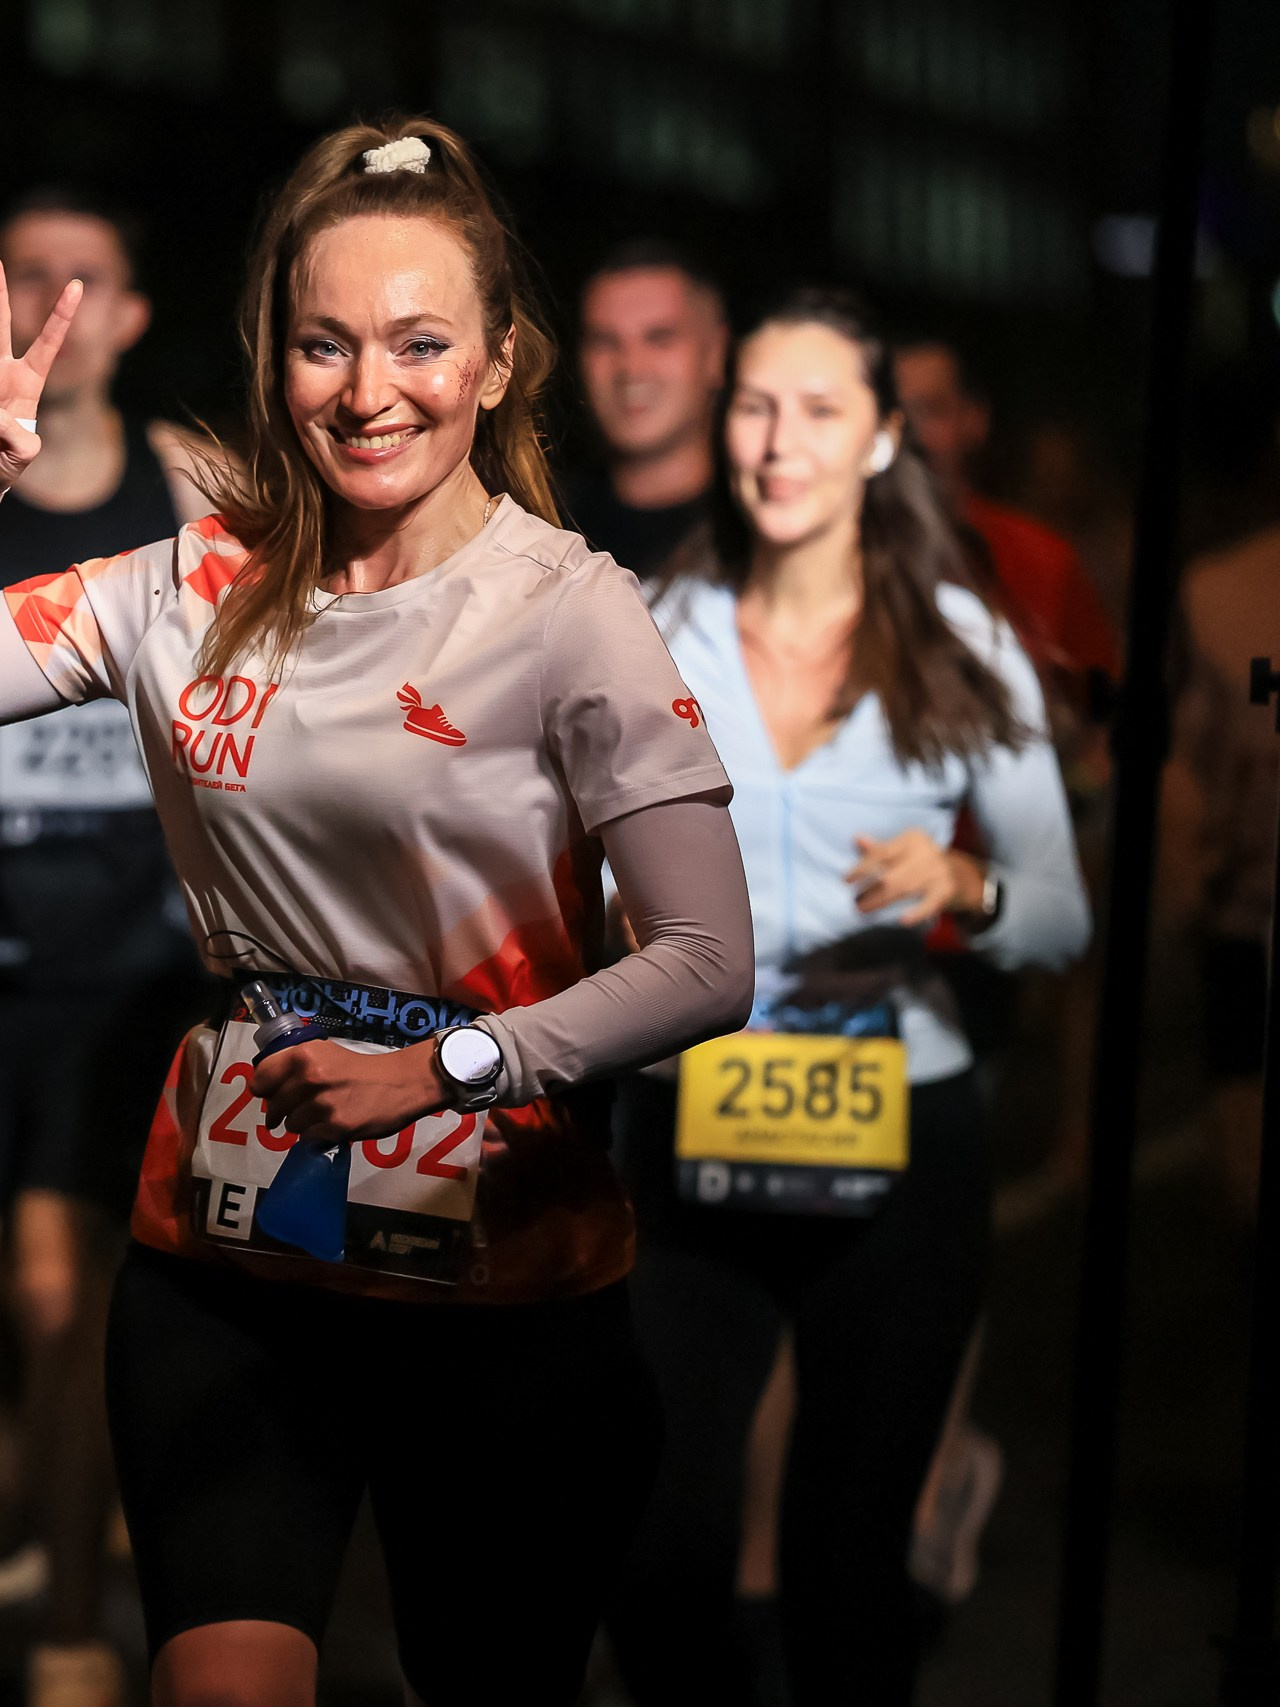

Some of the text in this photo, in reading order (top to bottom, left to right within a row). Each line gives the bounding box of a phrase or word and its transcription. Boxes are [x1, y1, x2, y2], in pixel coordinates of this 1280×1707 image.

[172, 719, 256, 778] RUN
[715, 1056, 884, 1124] 2585
[217, 1182, 246, 1229] E
